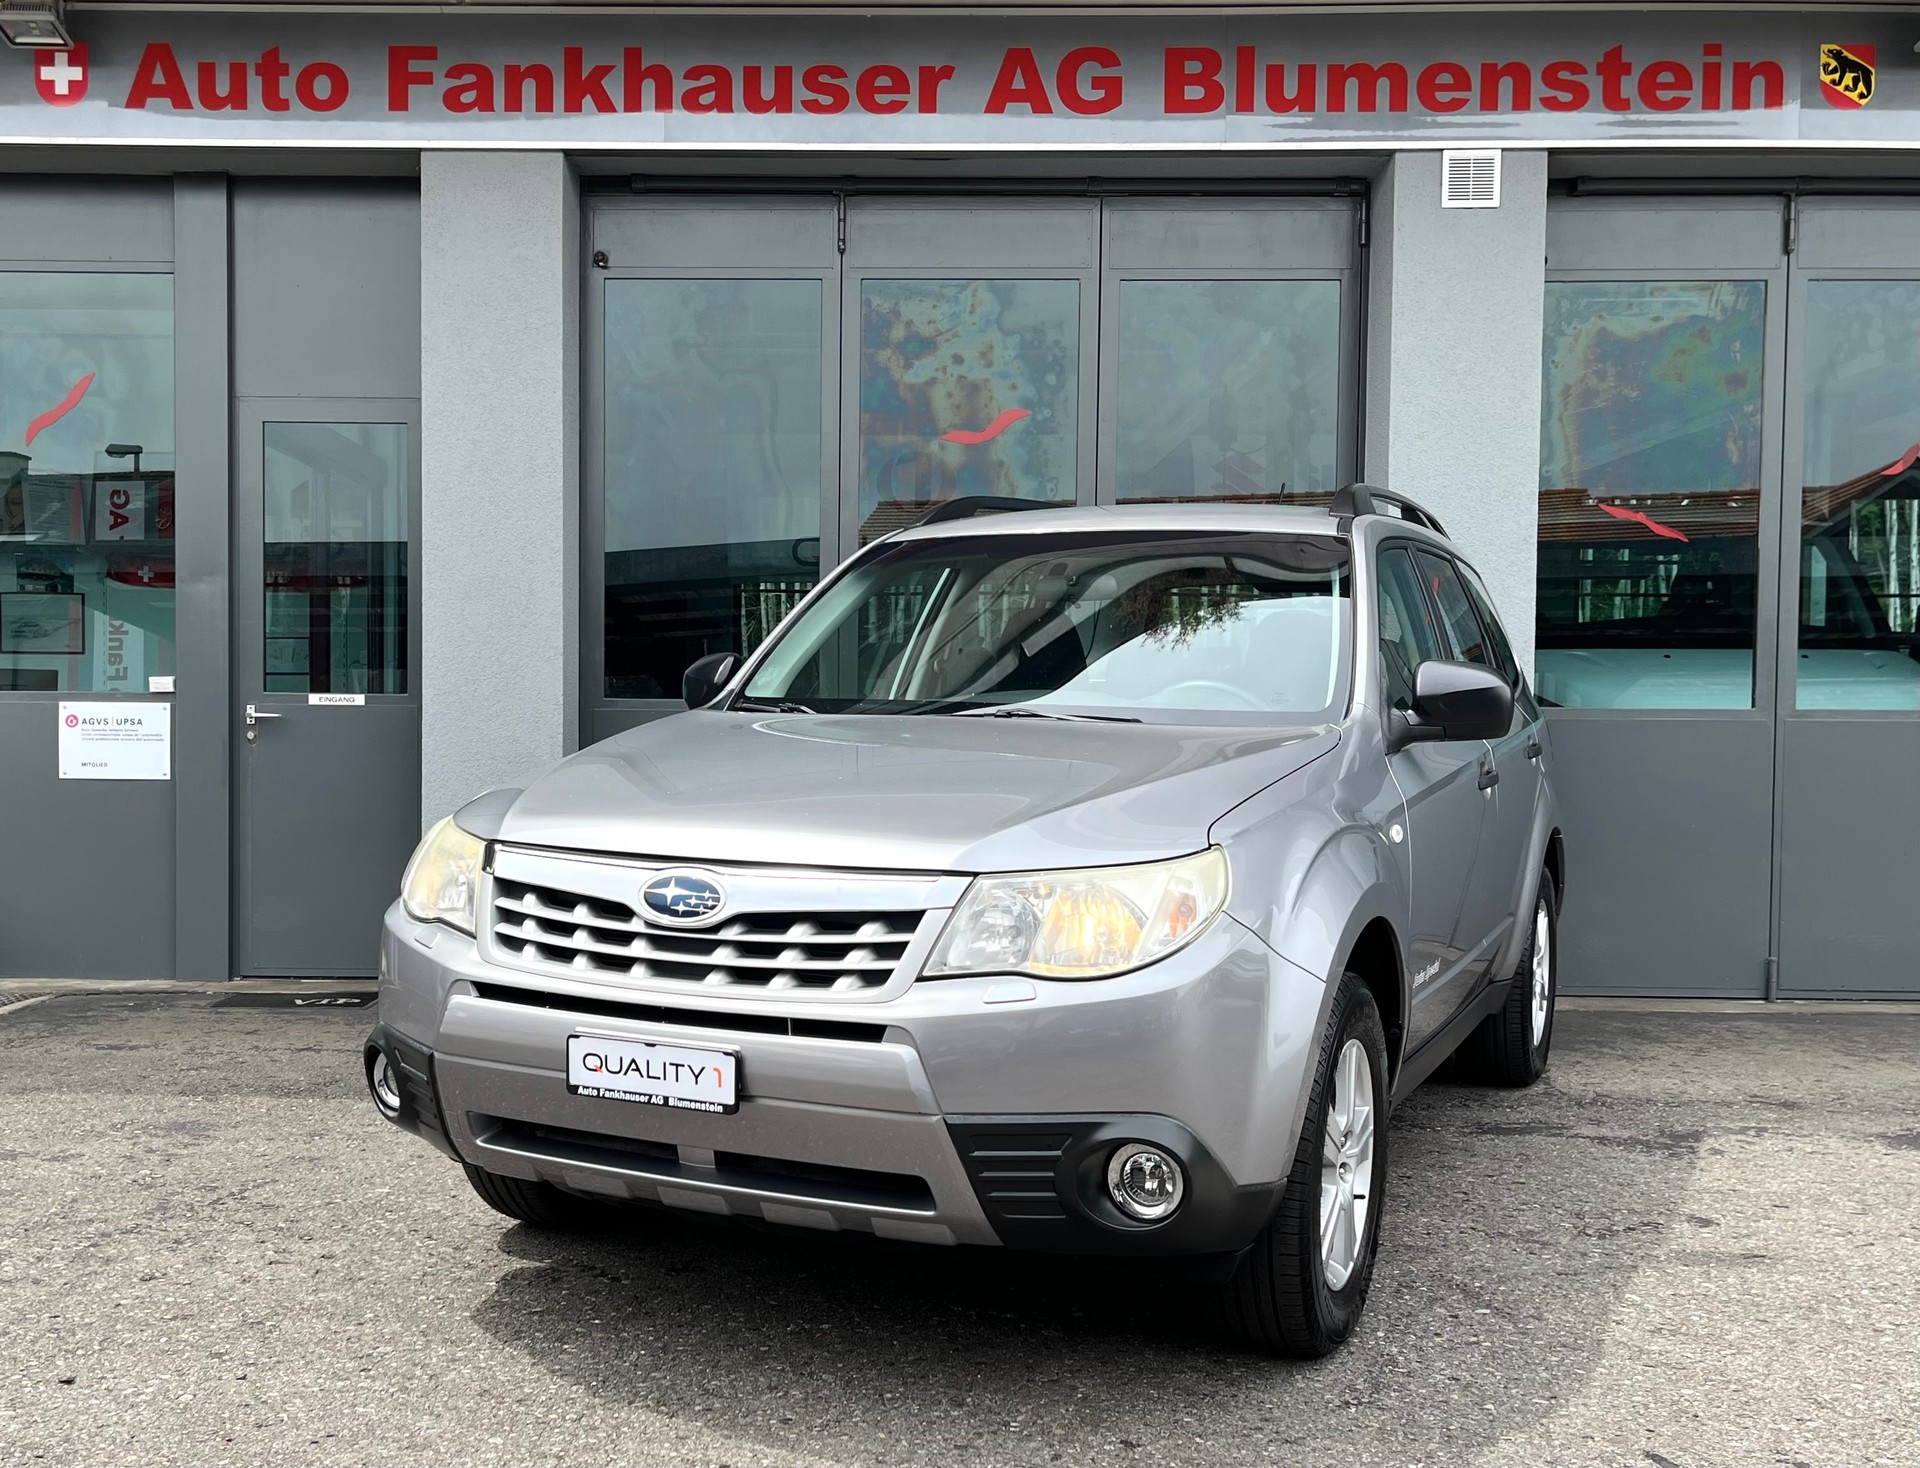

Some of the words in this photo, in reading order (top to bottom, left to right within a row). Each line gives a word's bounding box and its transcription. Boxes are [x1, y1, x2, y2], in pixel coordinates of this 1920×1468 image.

[125, 43, 350, 112] Auto
[388, 46, 954, 114] Fankhauser
[984, 47, 1123, 114] AG
[1164, 43, 1785, 114] Blumenstein
[81, 718, 109, 726] AGVS
[116, 718, 143, 726] UPSA
[583, 1053, 706, 1085] QUALITY
[712, 1066, 723, 1088] 1
[577, 1085, 598, 1097] Auto
[599, 1088, 650, 1104] Fankhauser
[650, 1094, 664, 1105] AG
[668, 1096, 724, 1113] Blumenstein
